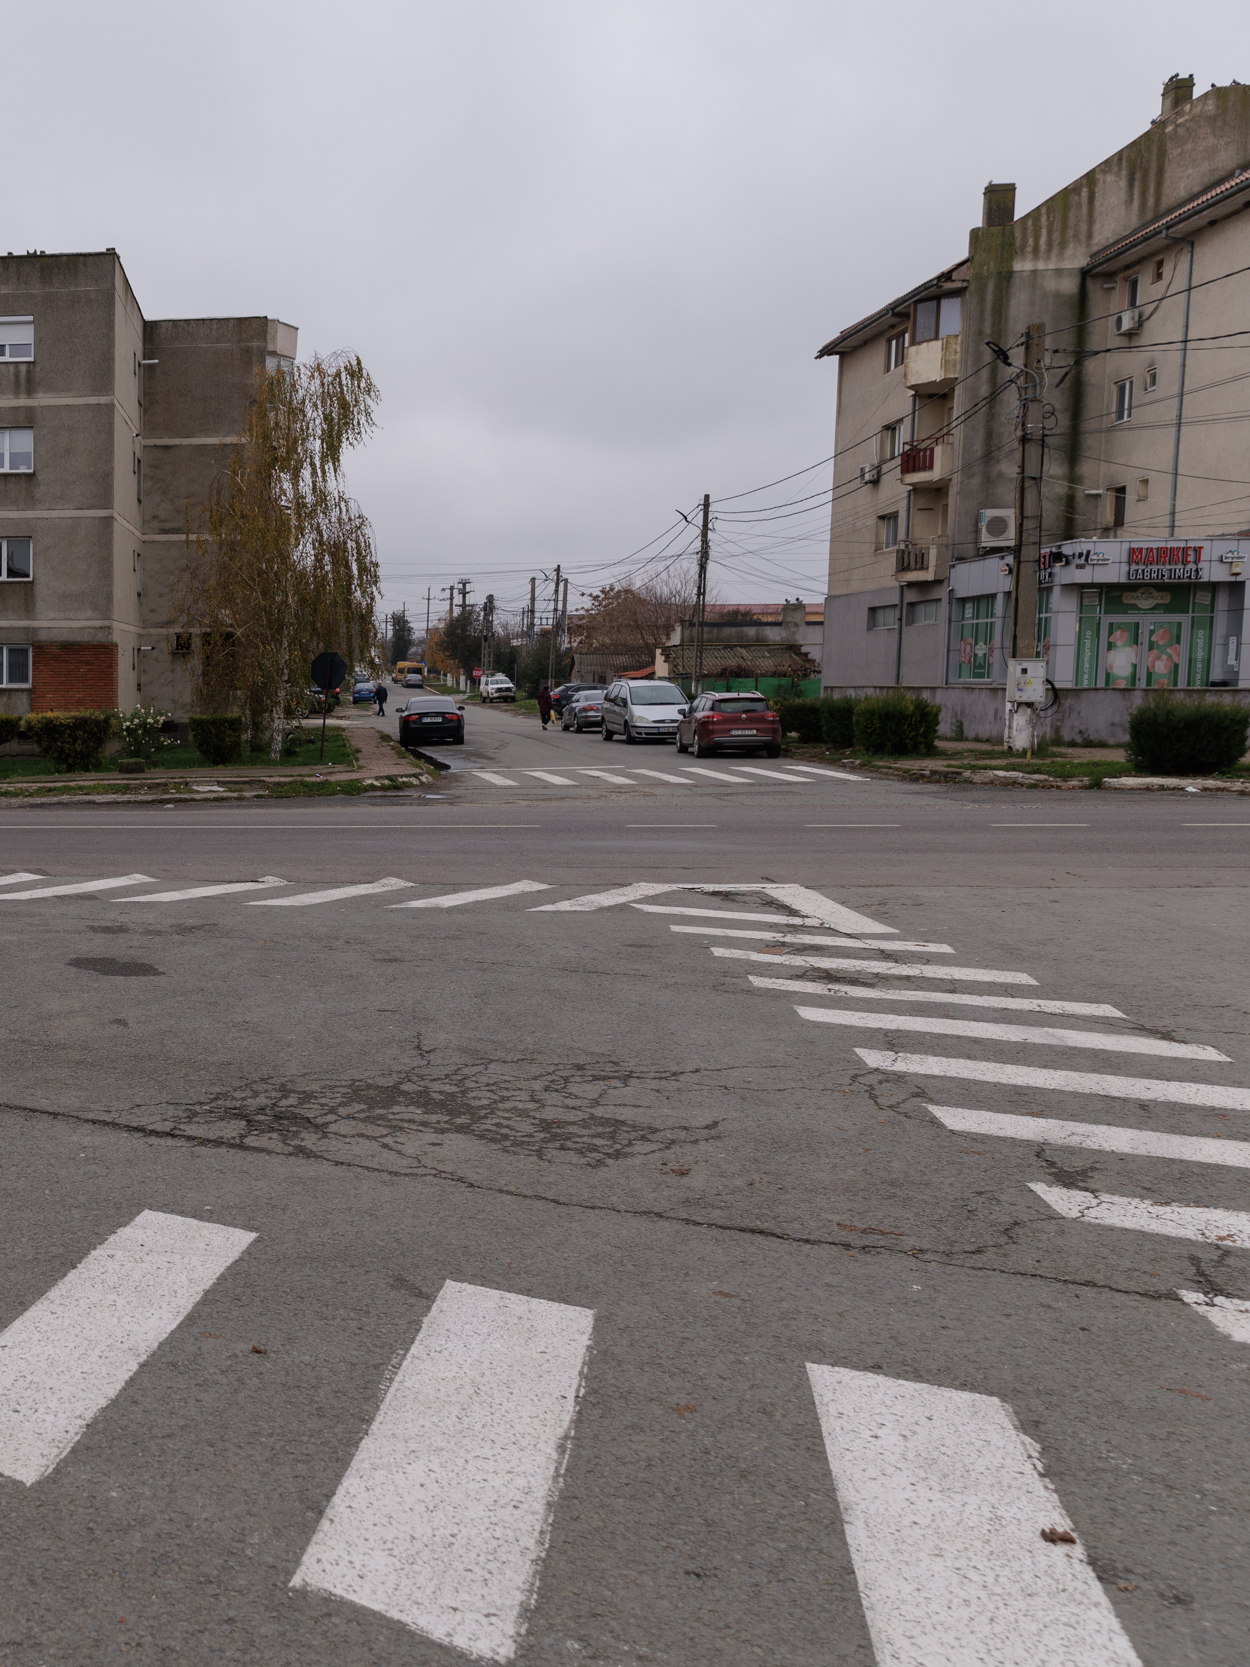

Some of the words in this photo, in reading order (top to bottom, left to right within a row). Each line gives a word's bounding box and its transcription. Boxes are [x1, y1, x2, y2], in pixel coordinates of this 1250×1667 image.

[1130, 546, 1204, 565] MARKET
[1129, 568, 1168, 580] GABRIS
[1171, 568, 1204, 580] IMPEX
[1125, 594, 1168, 602] CARNIPROD
[1195, 630, 1204, 687] ww.carniprod.ro
